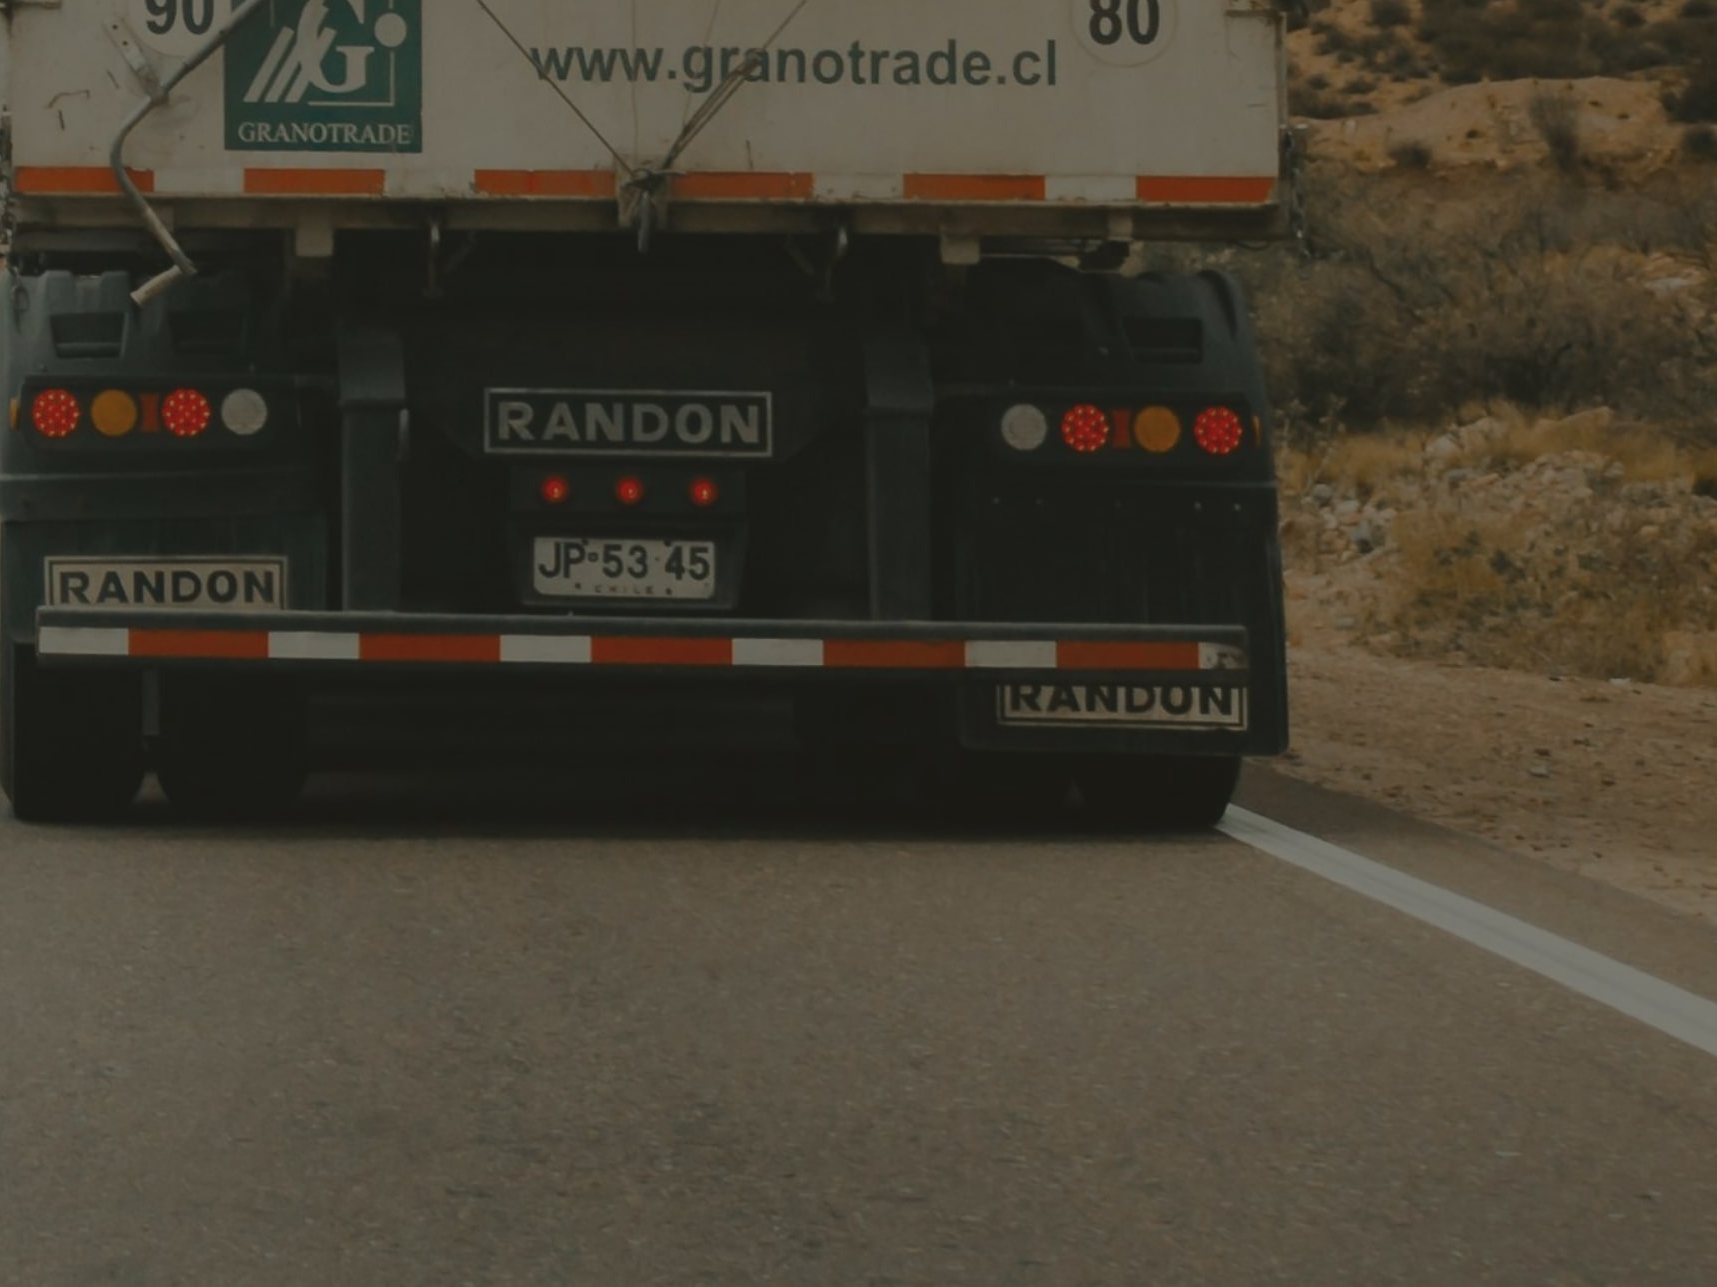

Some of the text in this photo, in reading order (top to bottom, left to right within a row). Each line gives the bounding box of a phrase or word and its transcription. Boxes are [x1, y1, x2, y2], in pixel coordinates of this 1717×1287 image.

[529, 39, 1056, 92] www.granotrade.cl
[238, 122, 412, 144] GRANOTRADE
[497, 401, 760, 443] RANDON
[664, 545, 710, 581] 45
[59, 570, 275, 603] RANDON
[1010, 685, 1233, 716] RANDON
